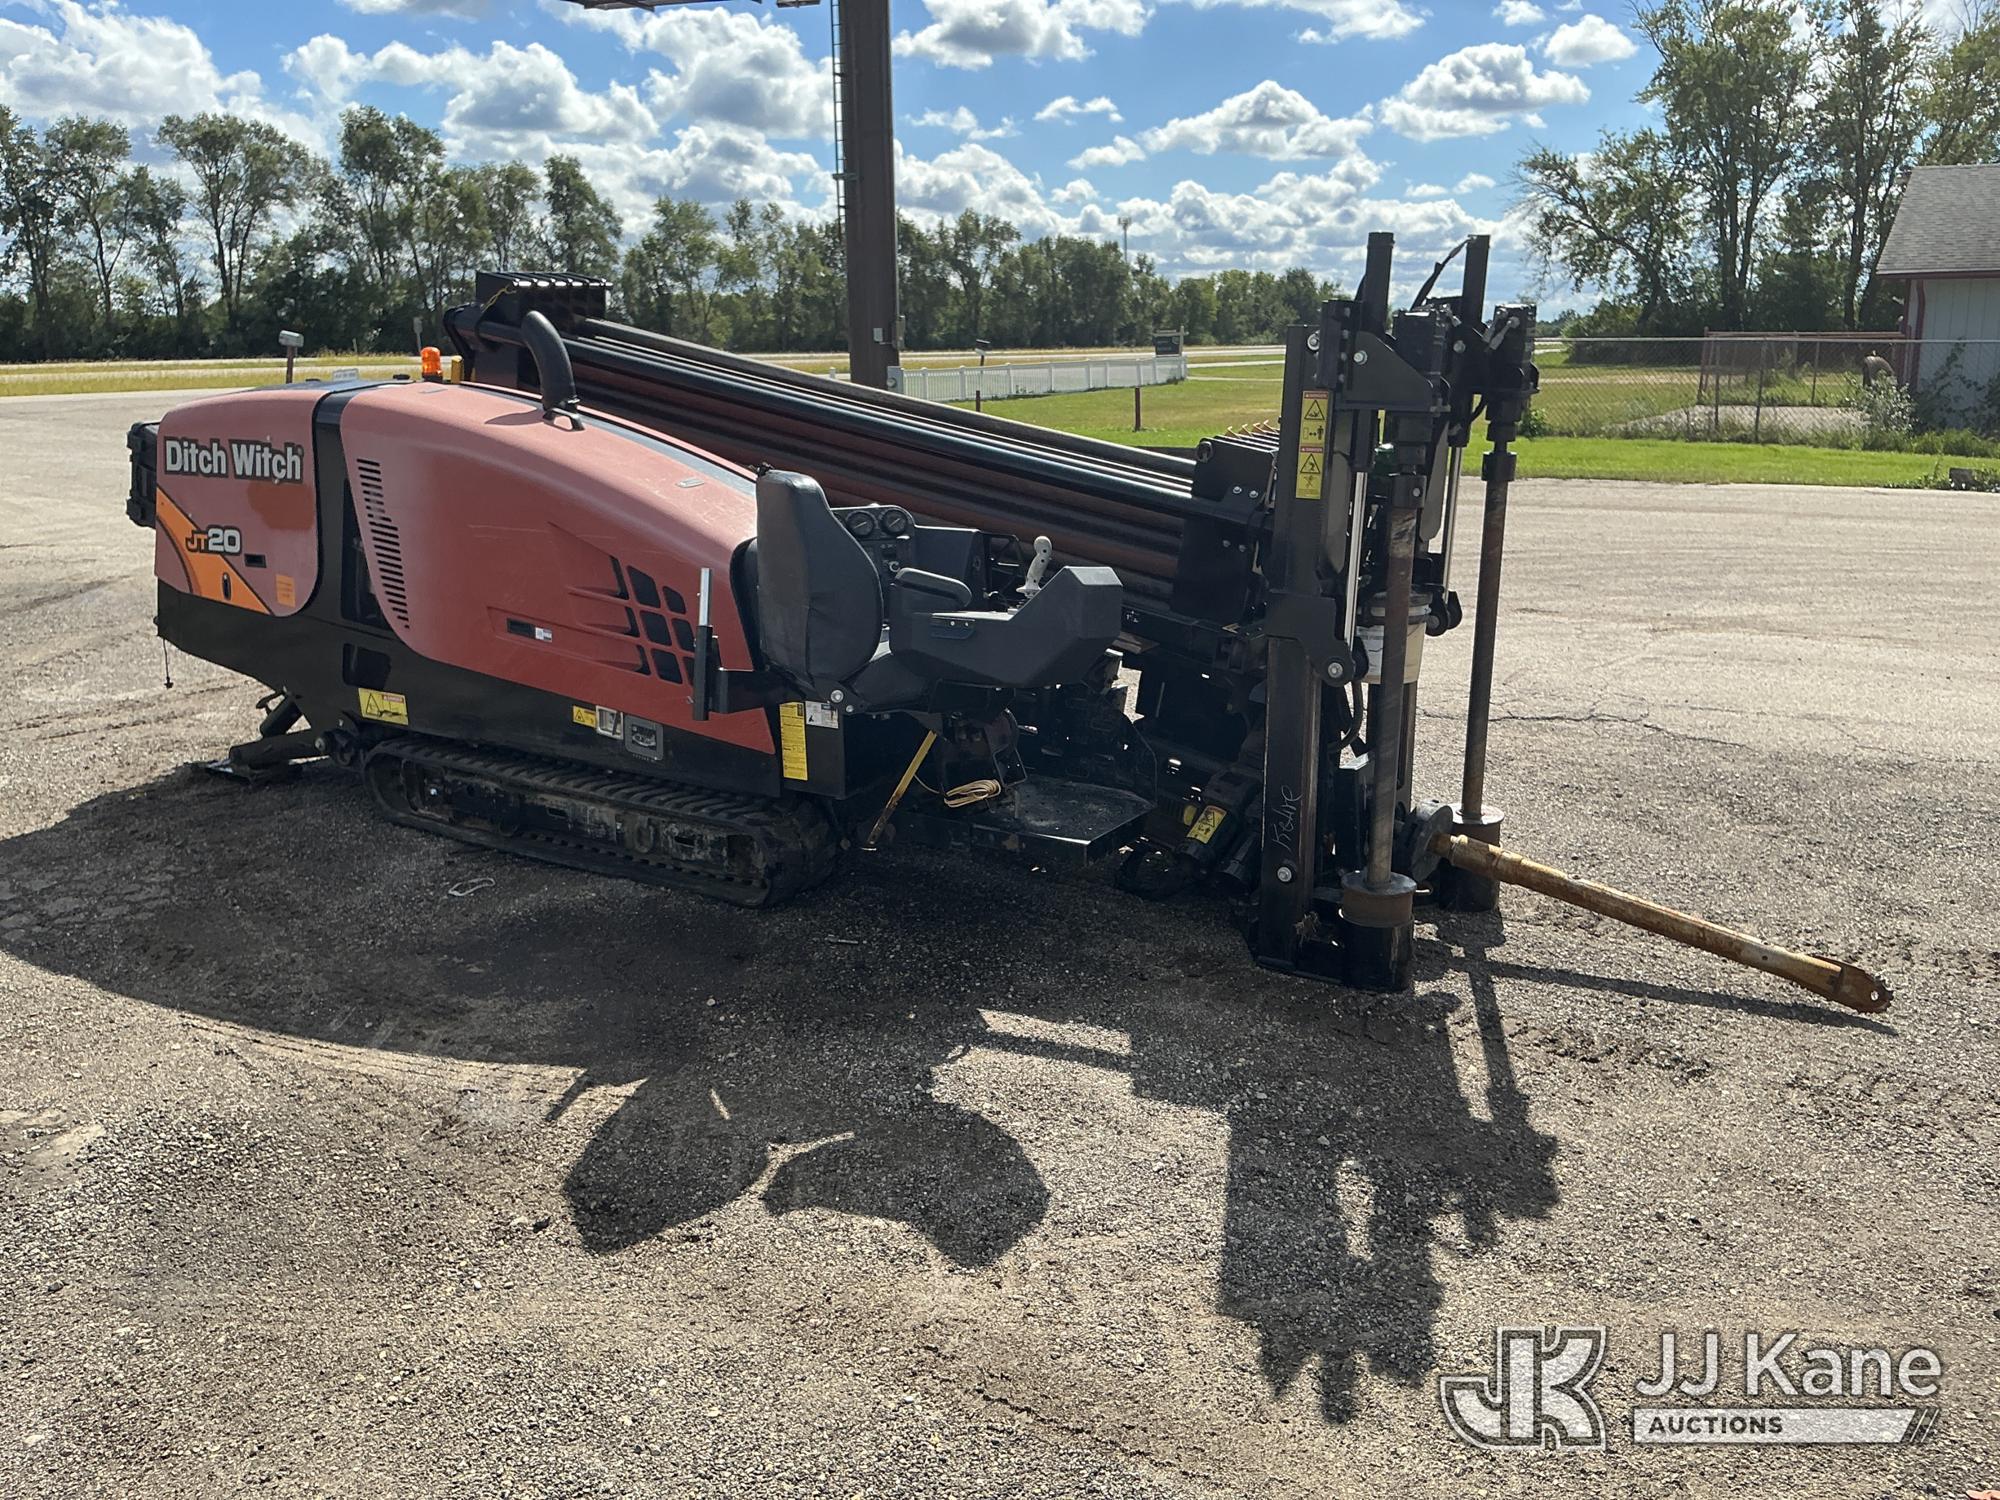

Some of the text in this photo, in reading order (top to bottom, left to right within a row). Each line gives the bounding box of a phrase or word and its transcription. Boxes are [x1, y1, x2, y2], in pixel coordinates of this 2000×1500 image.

[165, 439, 302, 480] Ditch Witch
[186, 527, 241, 554] JT20
